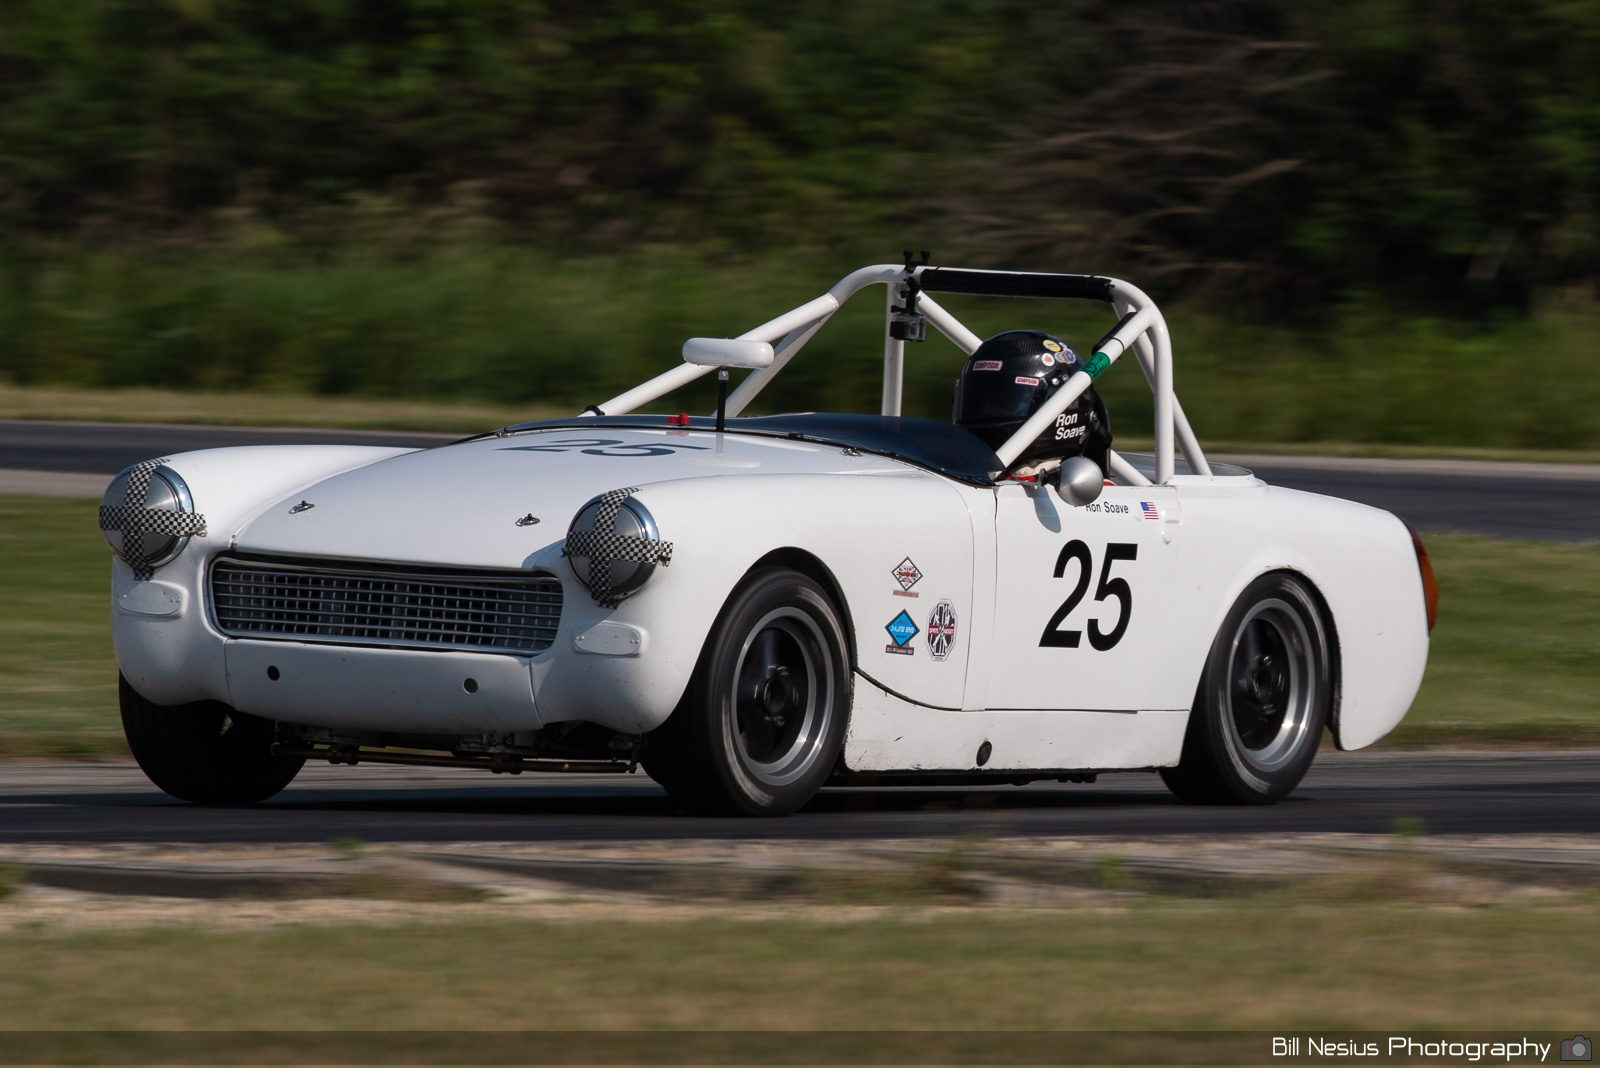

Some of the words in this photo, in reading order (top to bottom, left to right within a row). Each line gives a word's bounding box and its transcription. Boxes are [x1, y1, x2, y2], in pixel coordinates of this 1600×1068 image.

[974, 361, 1000, 370] SIMPSON
[1016, 377, 1038, 385] SIMPSON
[1055, 413, 1078, 428] Ron
[1055, 425, 1086, 440] Soave
[494, 439, 712, 457] 25
[1085, 501, 1101, 513] Ron
[1103, 501, 1129, 514] Soave
[1038, 539, 1138, 652] 25
